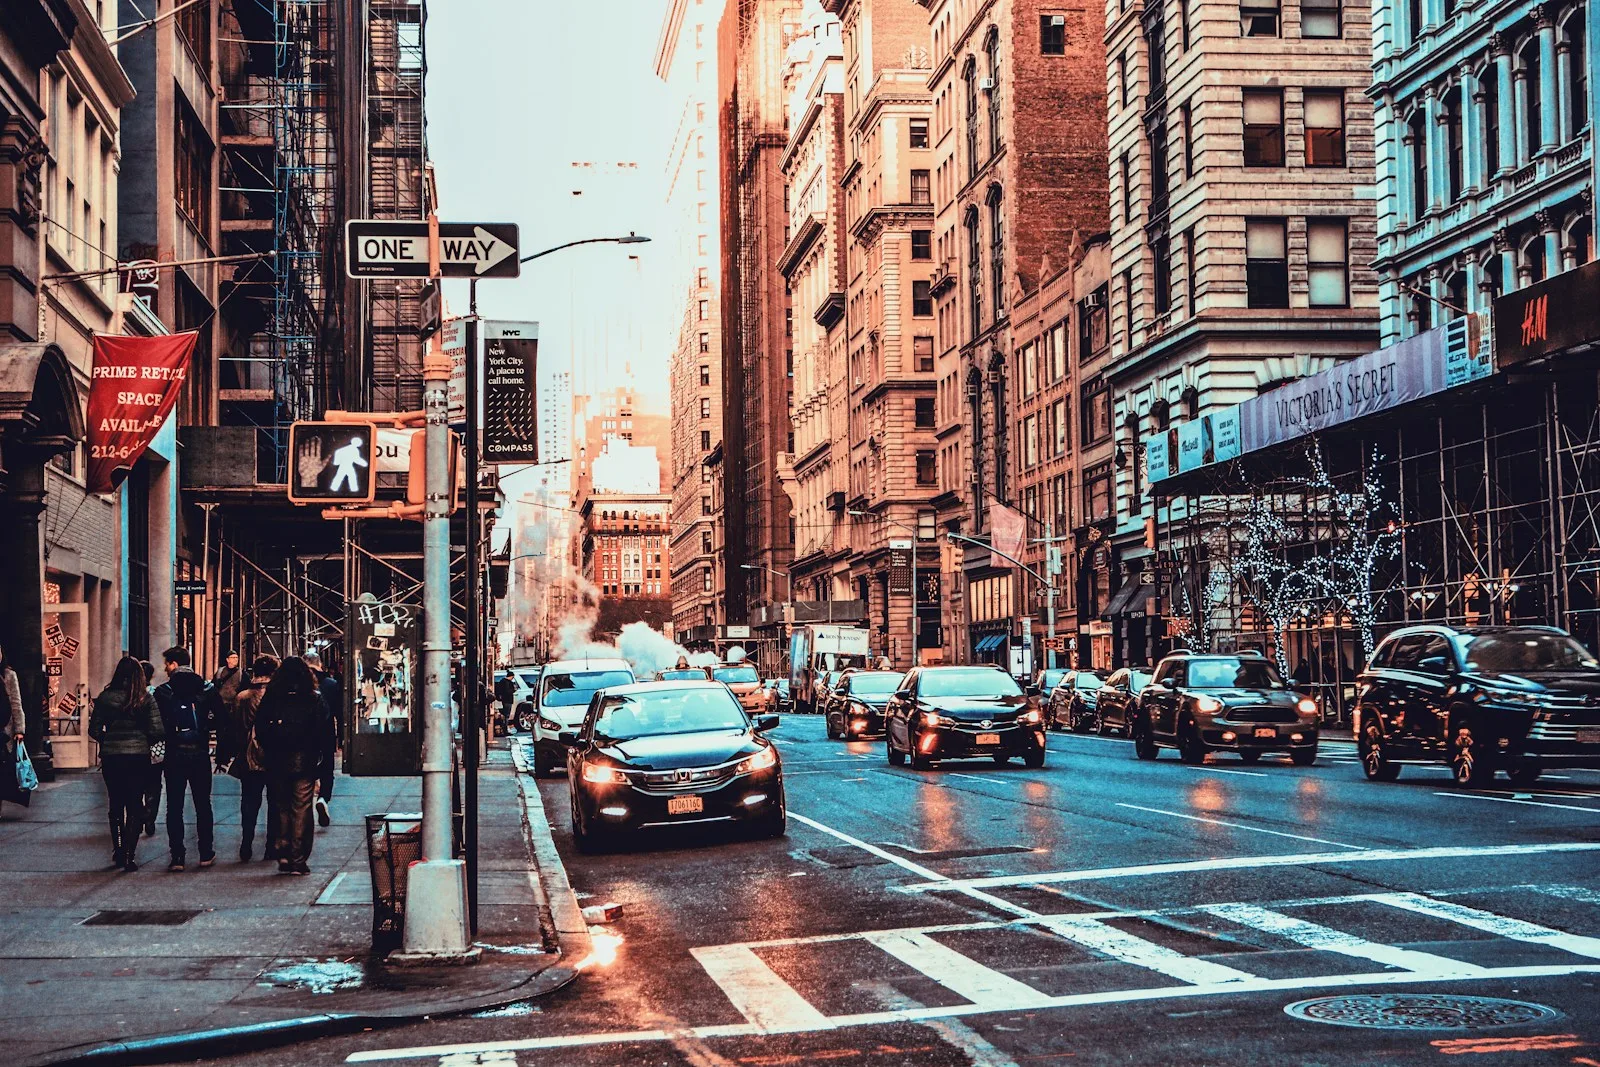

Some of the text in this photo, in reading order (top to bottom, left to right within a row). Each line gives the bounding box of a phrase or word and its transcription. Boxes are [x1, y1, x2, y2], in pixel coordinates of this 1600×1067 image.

[364, 239, 495, 260] ONE WAY
[488, 348, 506, 356] New
[488, 357, 524, 366] York City.
[92, 367, 137, 379] PRIME
[496, 368, 515, 378] place
[488, 376, 525, 385] call home.
[1276, 362, 1396, 428] VICTORIA'S SECRET
[488, 444, 534, 453] COMPASS
[48, 635, 64, 647] $15
[50, 666, 61, 675] $5
